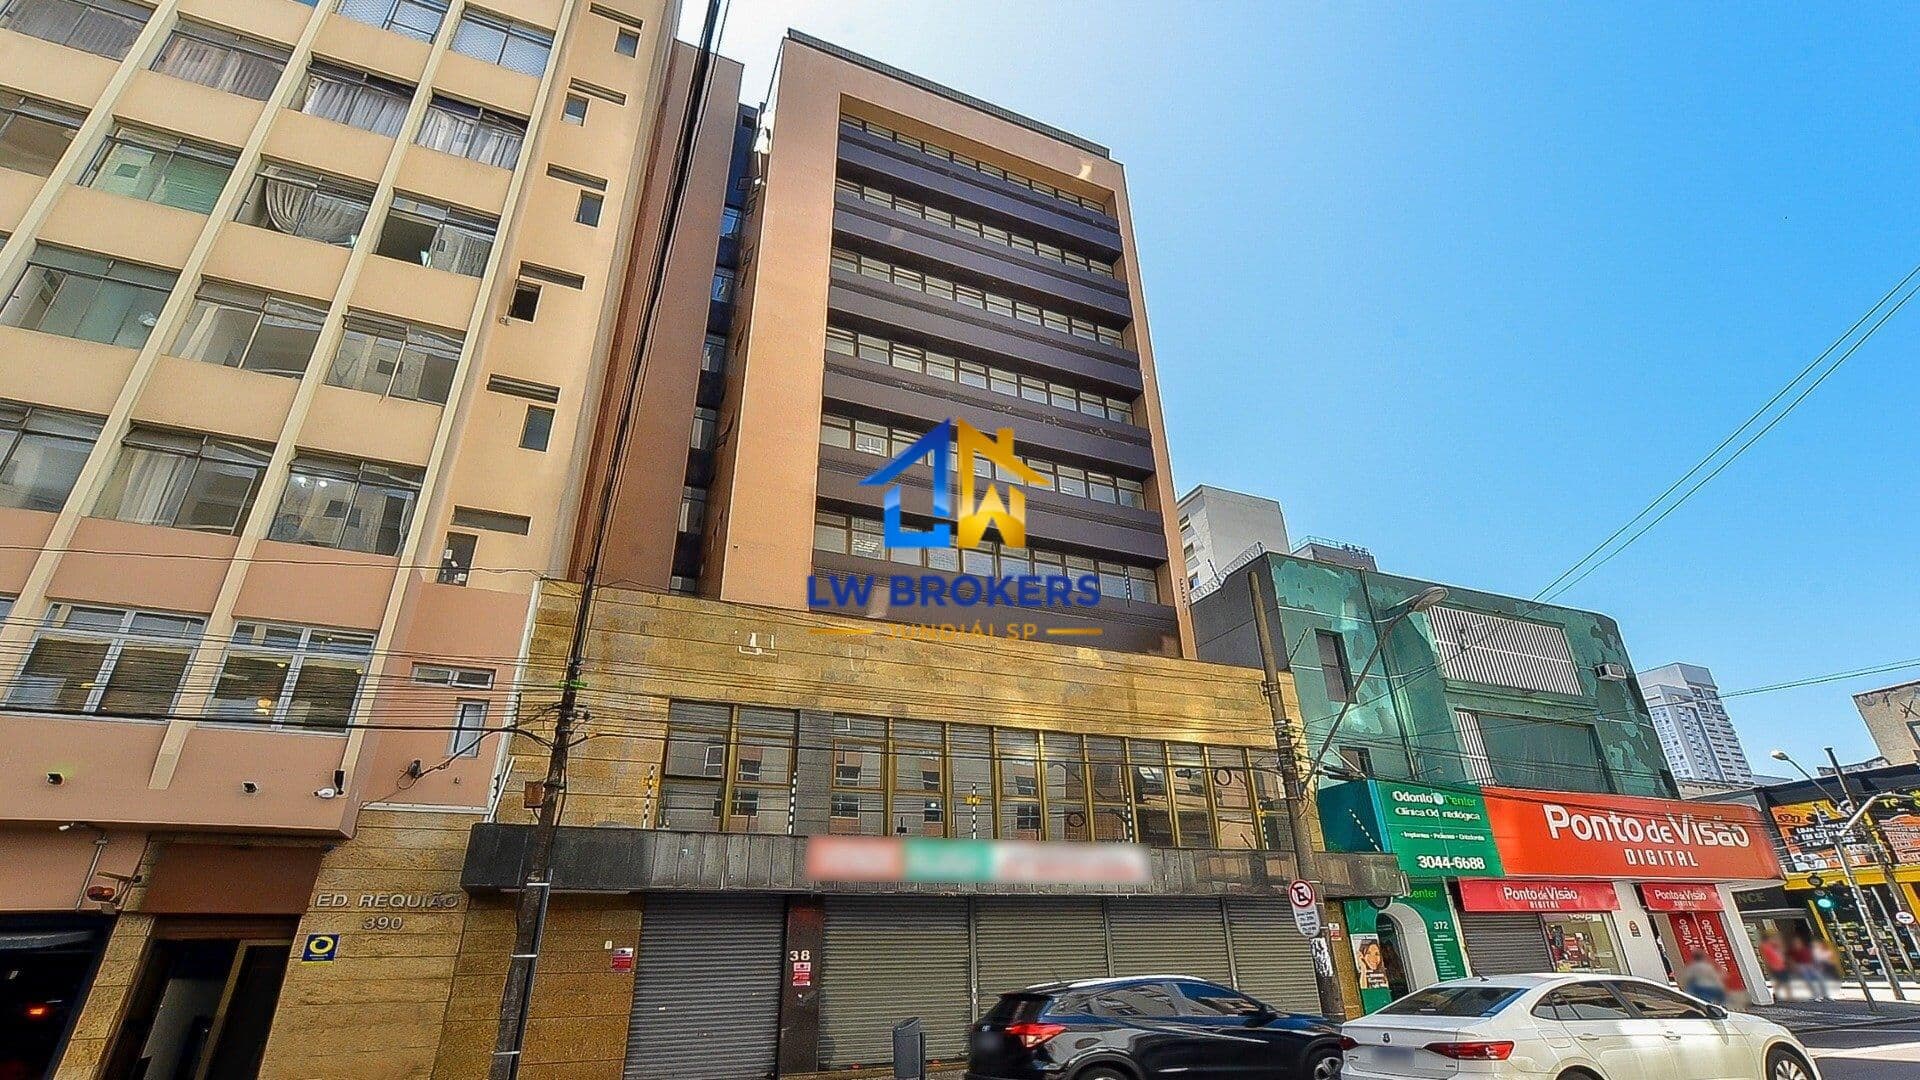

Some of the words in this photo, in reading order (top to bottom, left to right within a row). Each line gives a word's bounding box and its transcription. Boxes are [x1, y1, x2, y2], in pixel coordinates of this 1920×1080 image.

[1393, 791, 1432, 803] Odonto
[1543, 804, 1645, 844] Ponto
[1666, 812, 1750, 848] Visão
[1417, 855, 1486, 870] 3044-6688
[1624, 848, 1699, 867] DIGITAL
[316, 893, 350, 908] ED.
[358, 892, 460, 908] REQUIÃO
[1503, 886, 1538, 901] Ponto
[1545, 887, 1578, 900] Visão
[1654, 889, 1679, 900] Ponto
[362, 917, 403, 931] 390
[1433, 921, 1449, 930] 372
